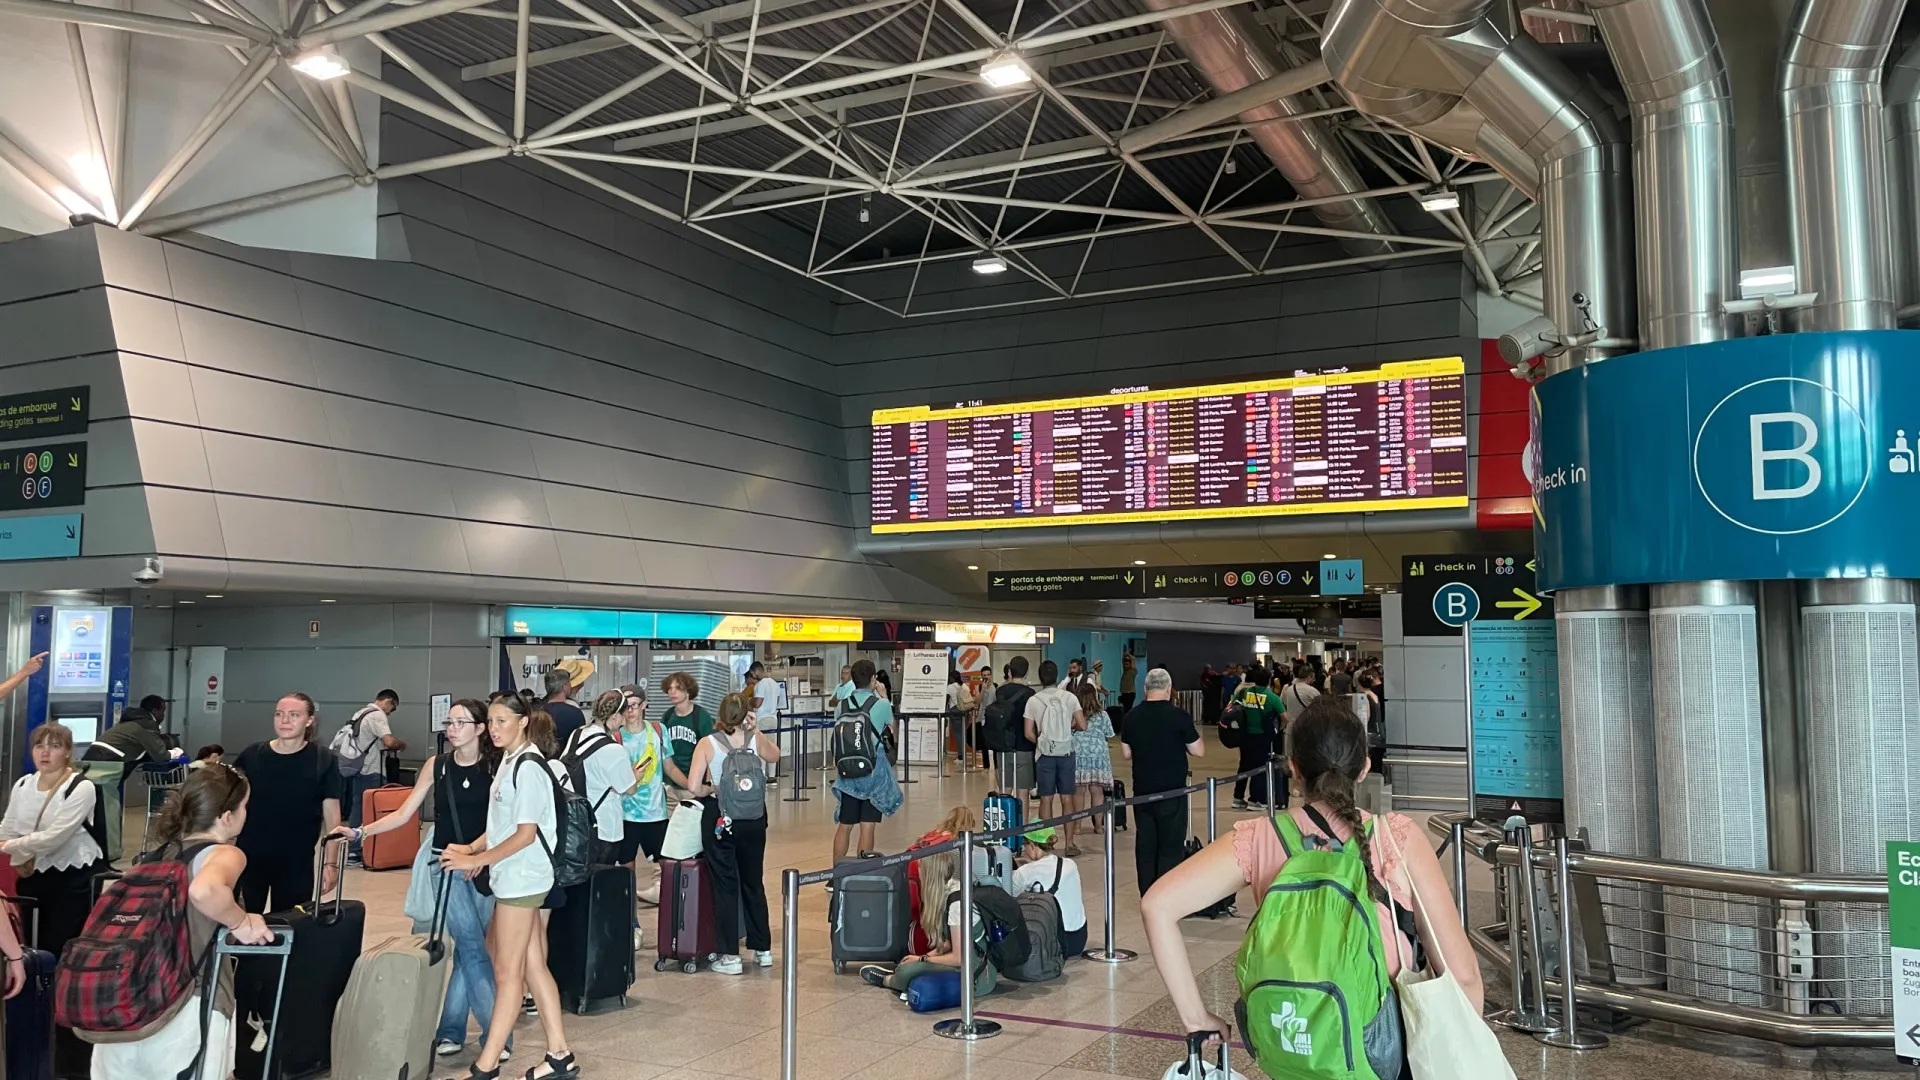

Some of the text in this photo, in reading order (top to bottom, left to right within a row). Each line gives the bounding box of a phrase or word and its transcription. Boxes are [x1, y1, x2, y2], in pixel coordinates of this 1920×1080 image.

[1111, 386, 1149, 394] departures
[8, 406, 17, 415] de
[19, 402, 57, 413] embarque
[15, 418, 33, 428] gates
[37, 414, 59, 423] terminal
[1750, 412, 1822, 500] B
[1534, 463, 1586, 494] check in
[1434, 563, 1464, 571] check
[1467, 562, 1476, 570] in
[1046, 575, 1084, 583] embarque
[1448, 592, 1467, 617] B
[784, 623, 803, 631] LGSP
[677, 725, 697, 745] DIEGO
[883, 857, 900, 866] Lufthansa
